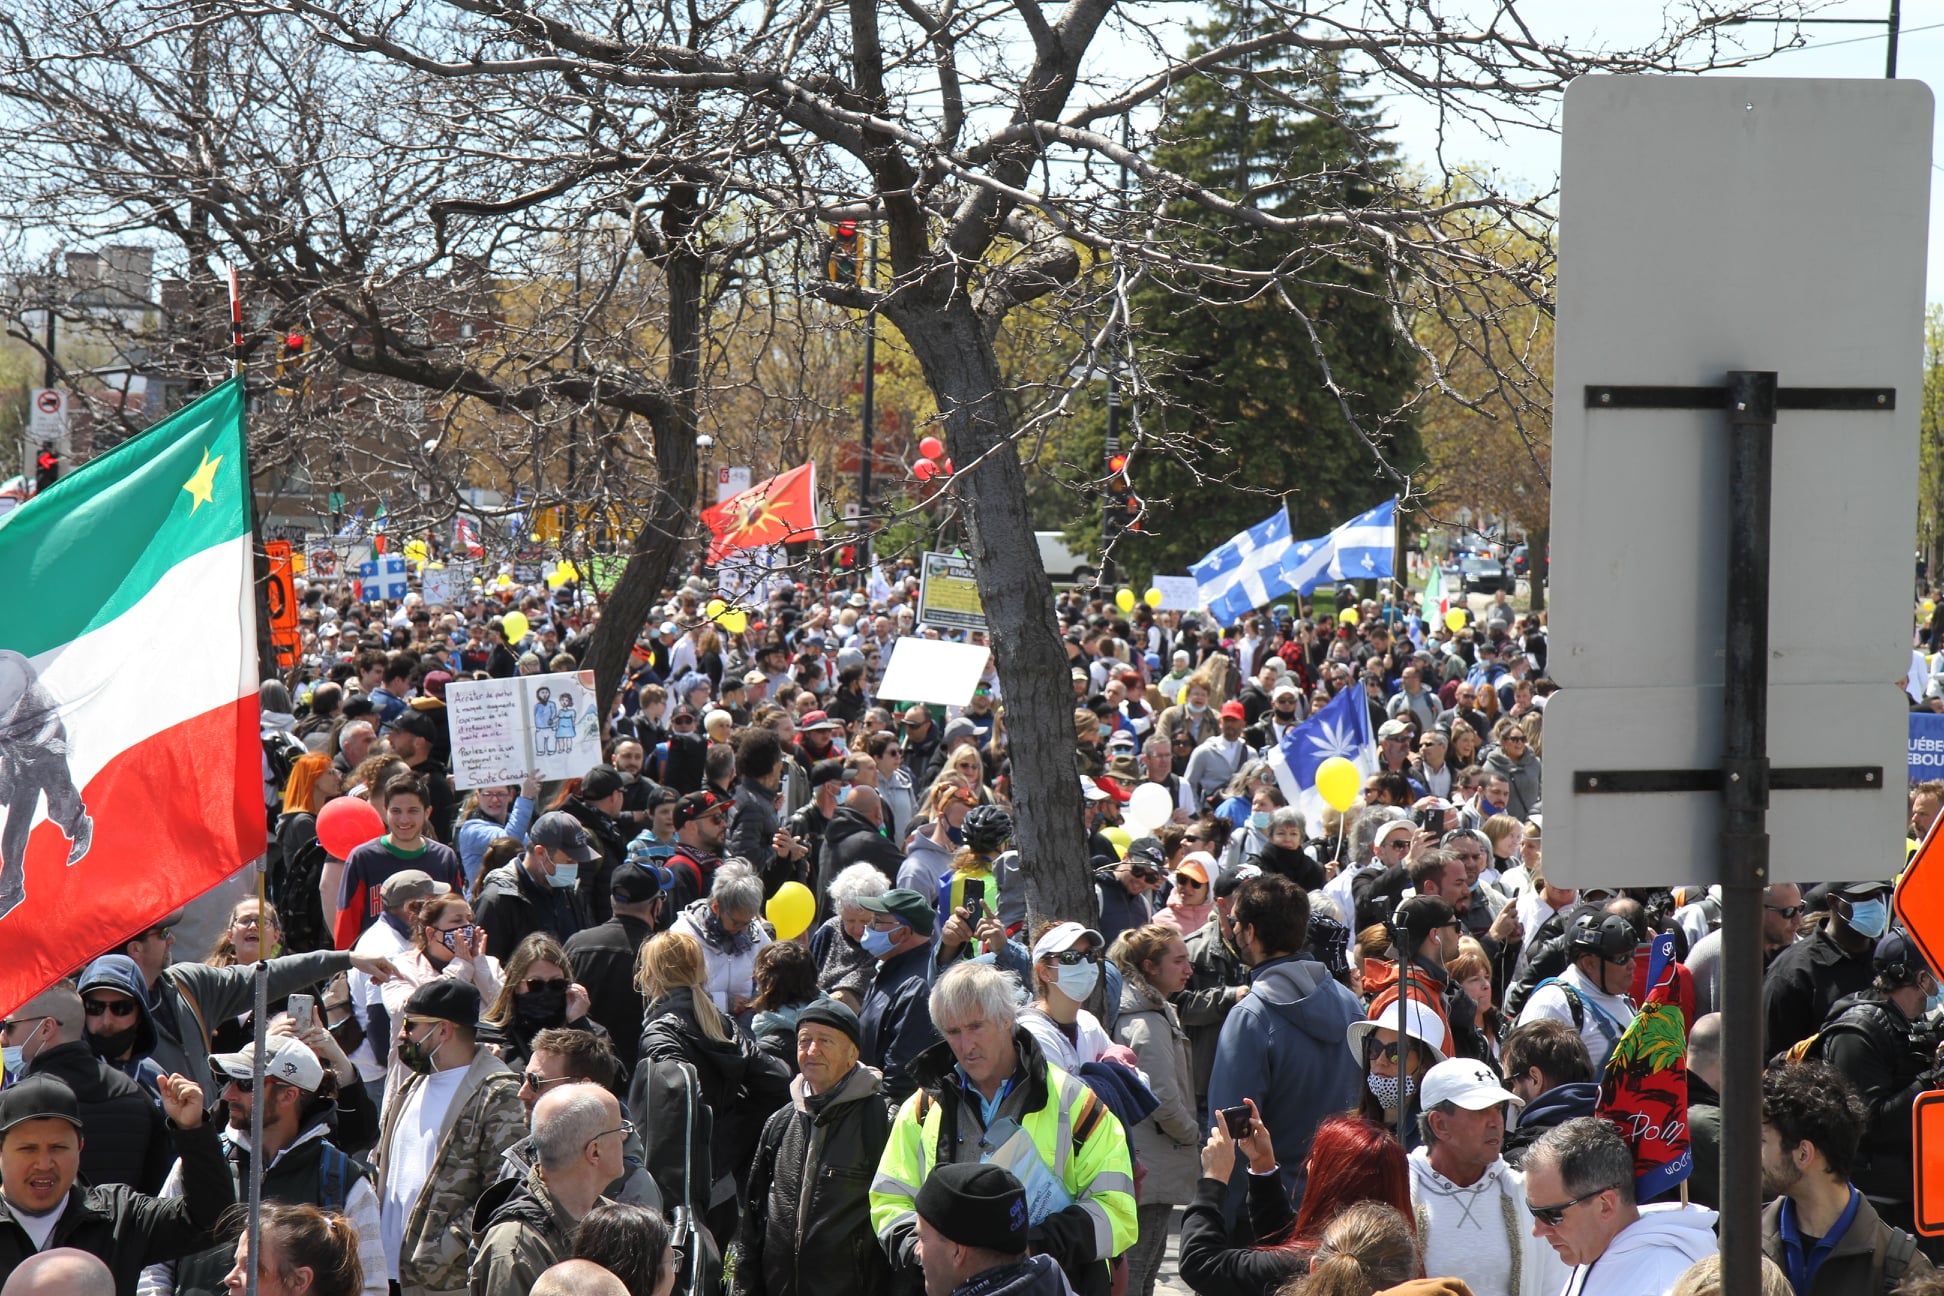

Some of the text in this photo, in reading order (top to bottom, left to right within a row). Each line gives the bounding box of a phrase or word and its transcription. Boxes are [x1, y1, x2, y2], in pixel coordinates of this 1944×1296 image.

[1908, 736, 1944, 753] UÉBE
[468, 767, 529, 786] Santé Canada
